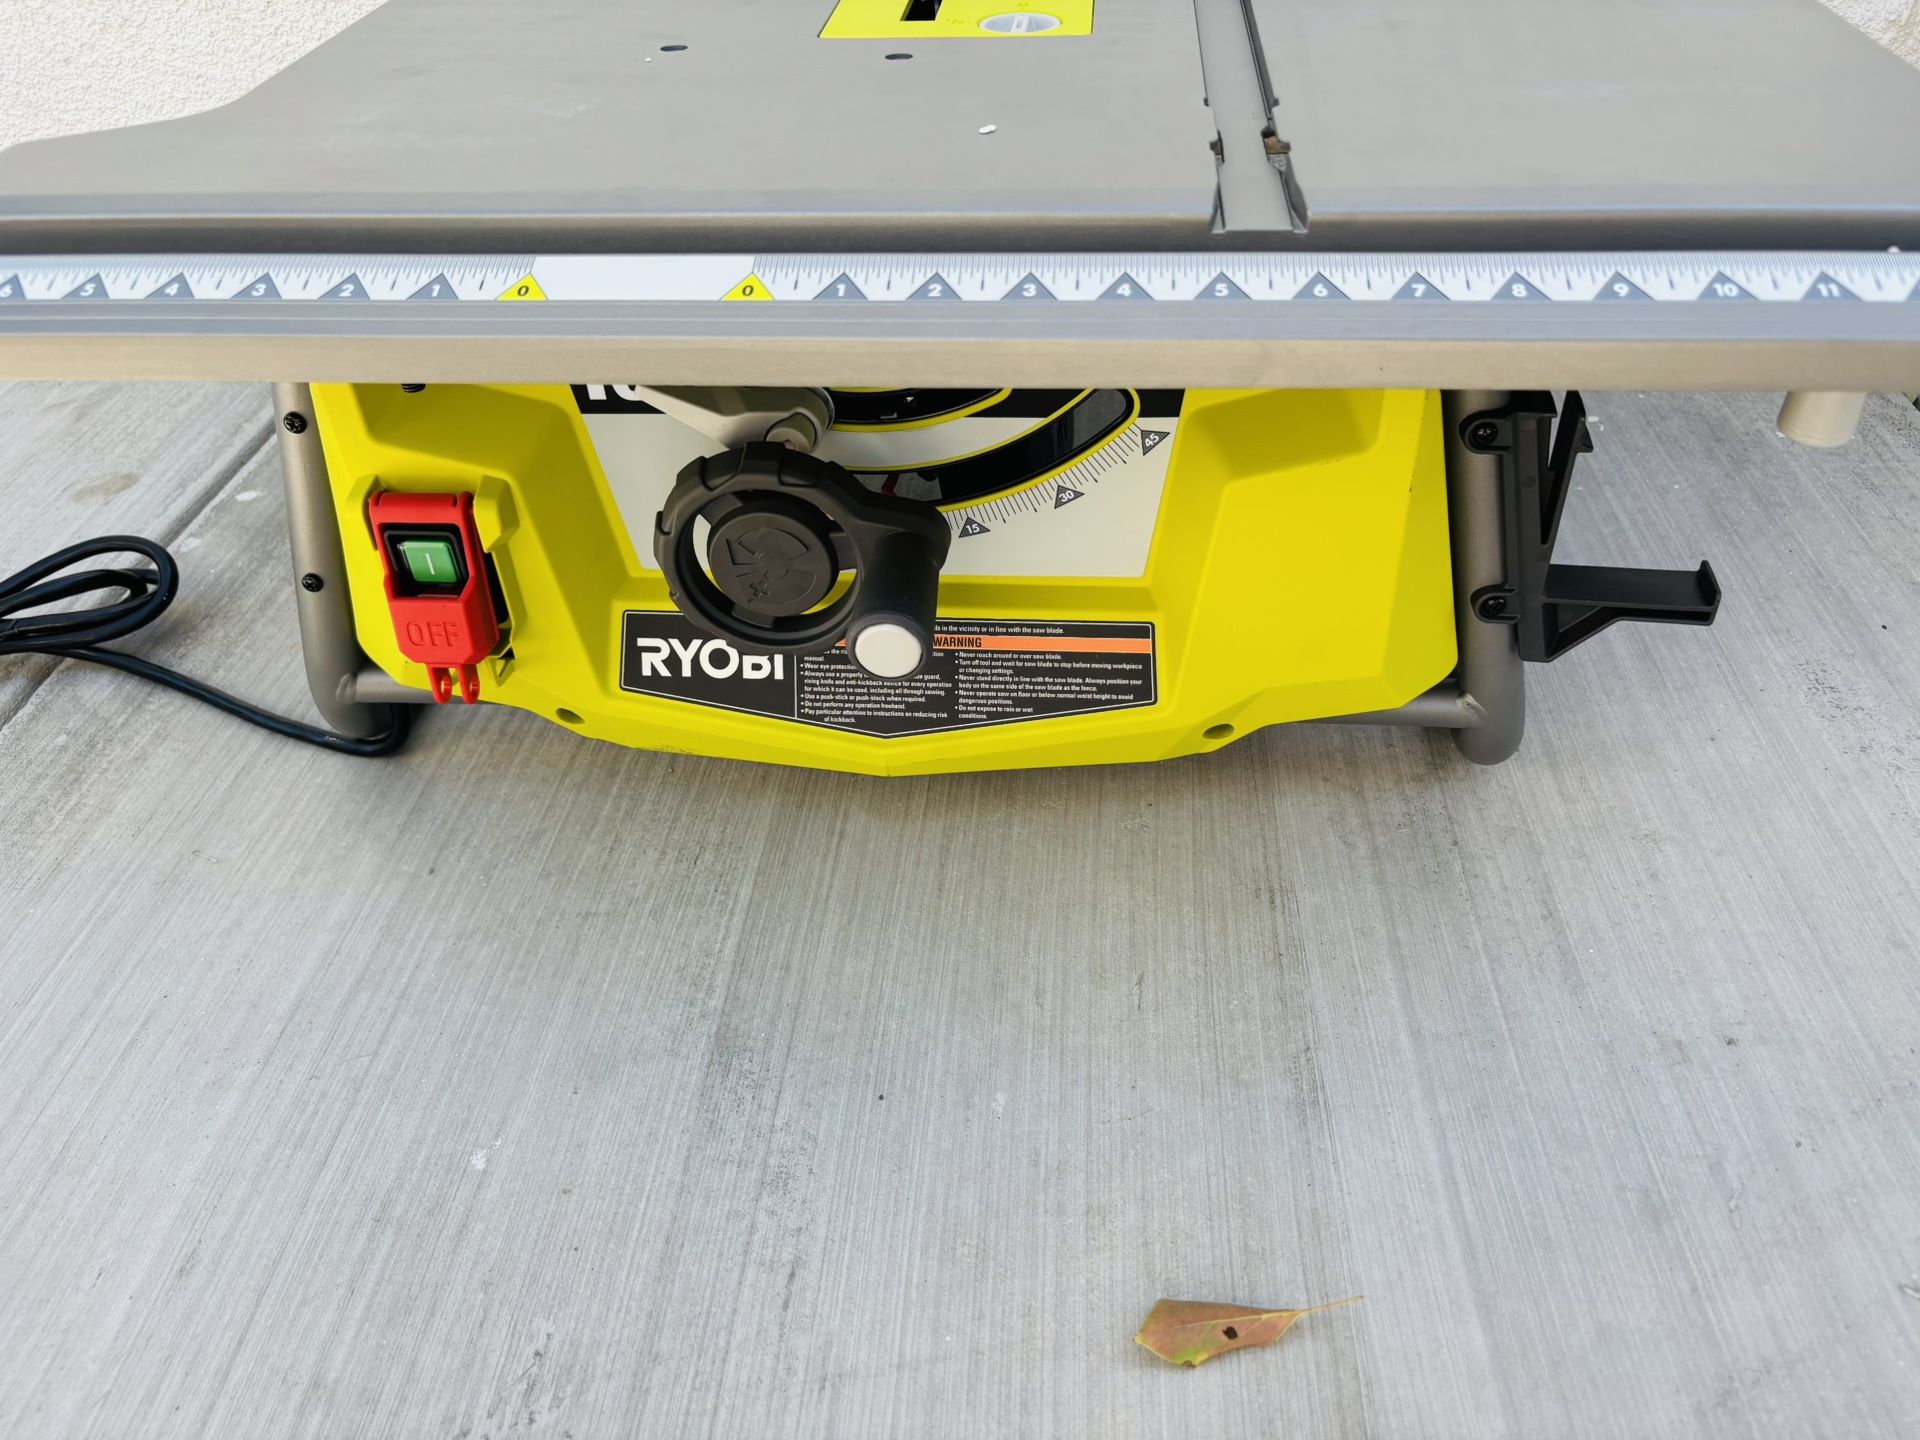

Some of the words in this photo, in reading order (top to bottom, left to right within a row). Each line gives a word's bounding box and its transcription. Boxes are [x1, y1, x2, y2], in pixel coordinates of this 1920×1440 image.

[0, 285, 12, 297] 6
[80, 284, 96, 296] 5
[165, 284, 180, 296] 4
[251, 284, 267, 296] 3
[339, 285, 355, 297] 2
[431, 285, 441, 297] 1
[517, 285, 529, 297] 0
[742, 285, 753, 297] 0
[836, 284, 846, 296] 1
[928, 284, 942, 296] 2
[1022, 284, 1037, 297] 3
[1116, 284, 1131, 297] 4
[1215, 284, 1228, 296] 5
[1313, 284, 1328, 296] 6
[1412, 284, 1425, 297] 7
[1512, 284, 1527, 297] 8
[1613, 283, 1629, 297] 9
[1713, 284, 1738, 297] 10
[1816, 284, 1841, 297] 11
[1144, 433, 1159, 448] 45
[1059, 490, 1074, 502] 30
[966, 524, 980, 534] 15
[406, 620, 460, 647] OFF
[933, 637, 982, 648] WARNING
[636, 637, 784, 680] RYOBI
[1085, 677, 1106, 685] Always
[903, 688, 924, 696] through
